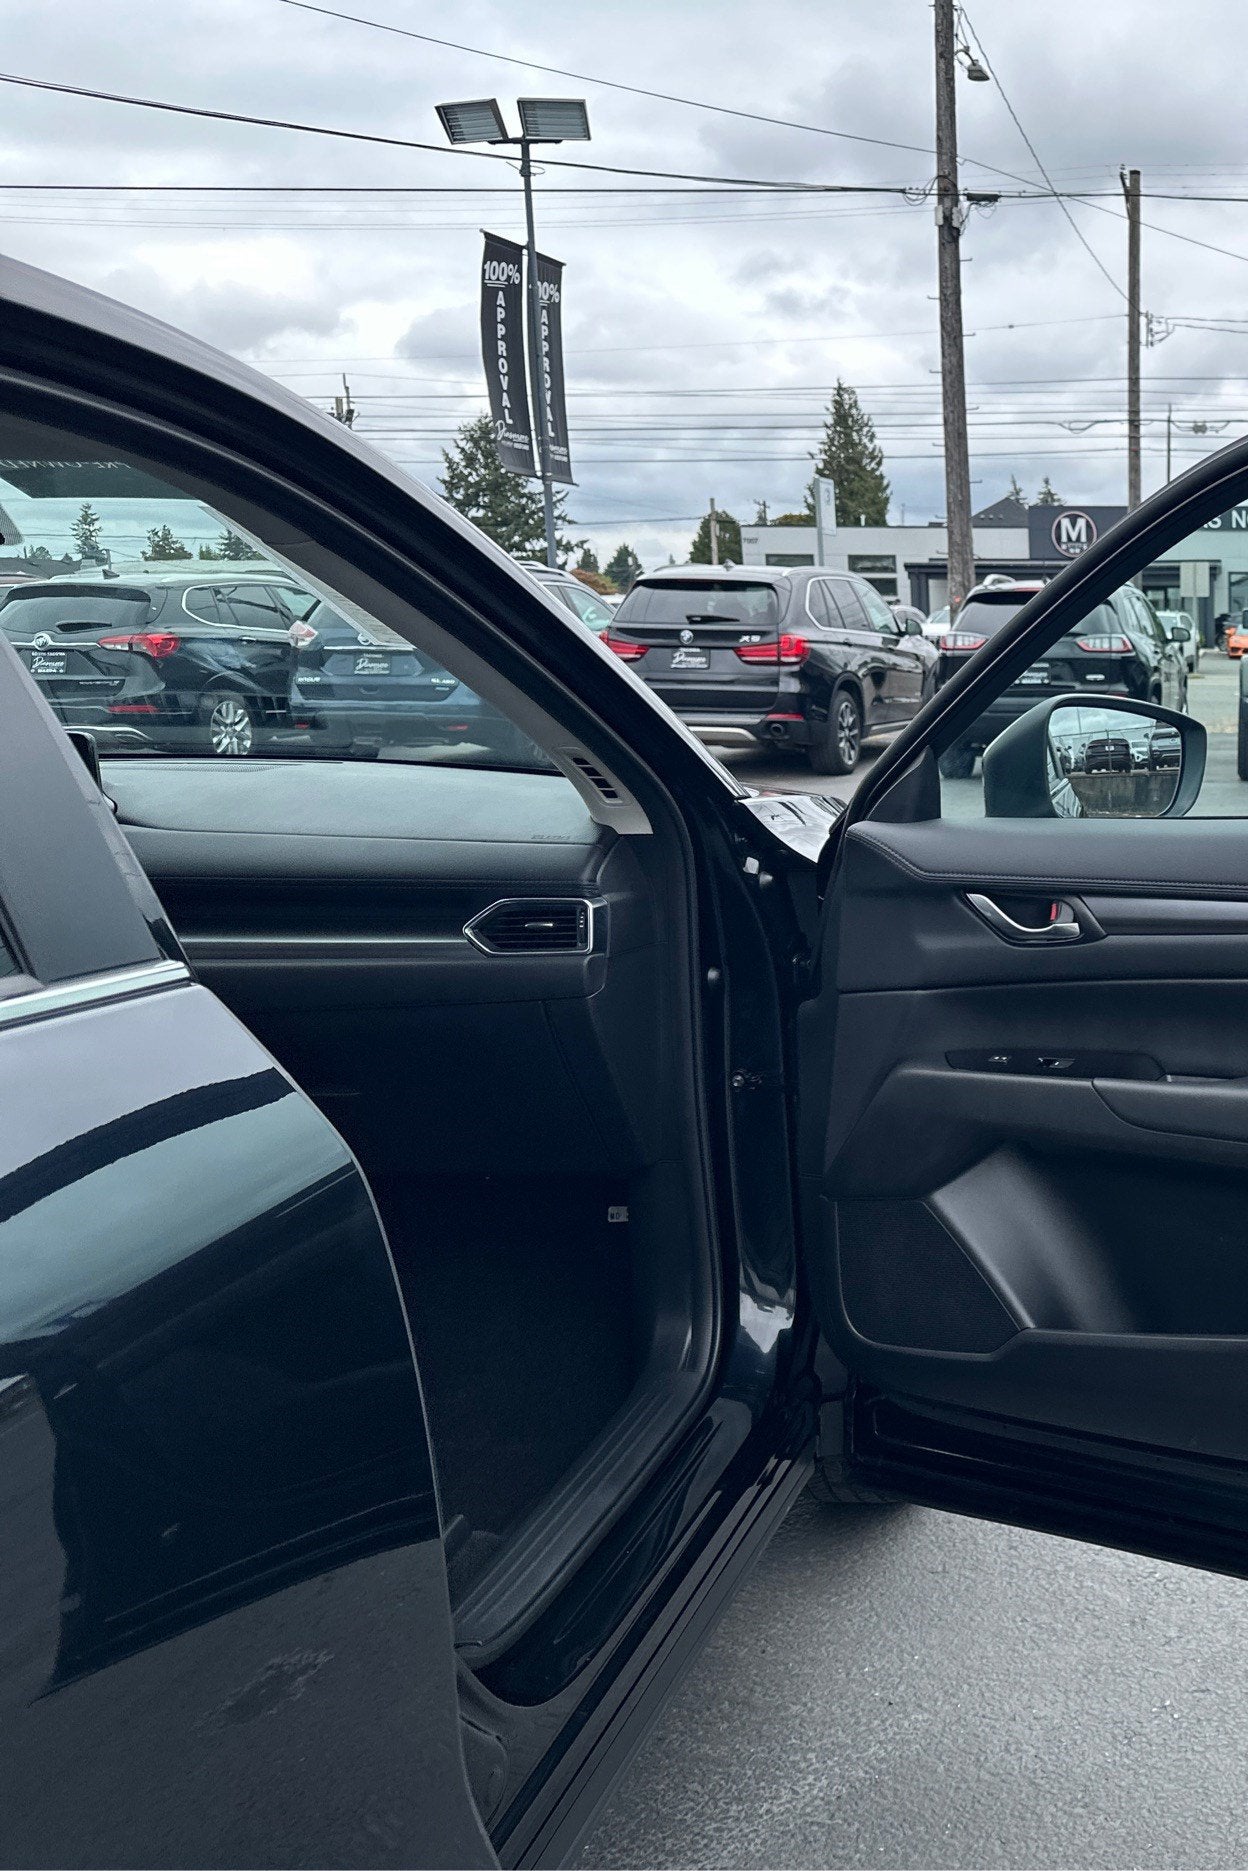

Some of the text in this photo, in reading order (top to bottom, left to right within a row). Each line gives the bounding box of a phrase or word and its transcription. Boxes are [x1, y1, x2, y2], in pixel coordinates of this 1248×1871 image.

[484, 260, 521, 285] 100%
[496, 290, 514, 425] APPROVAL
[540, 309, 556, 438] APPROVAL
[1060, 516, 1088, 543] M
